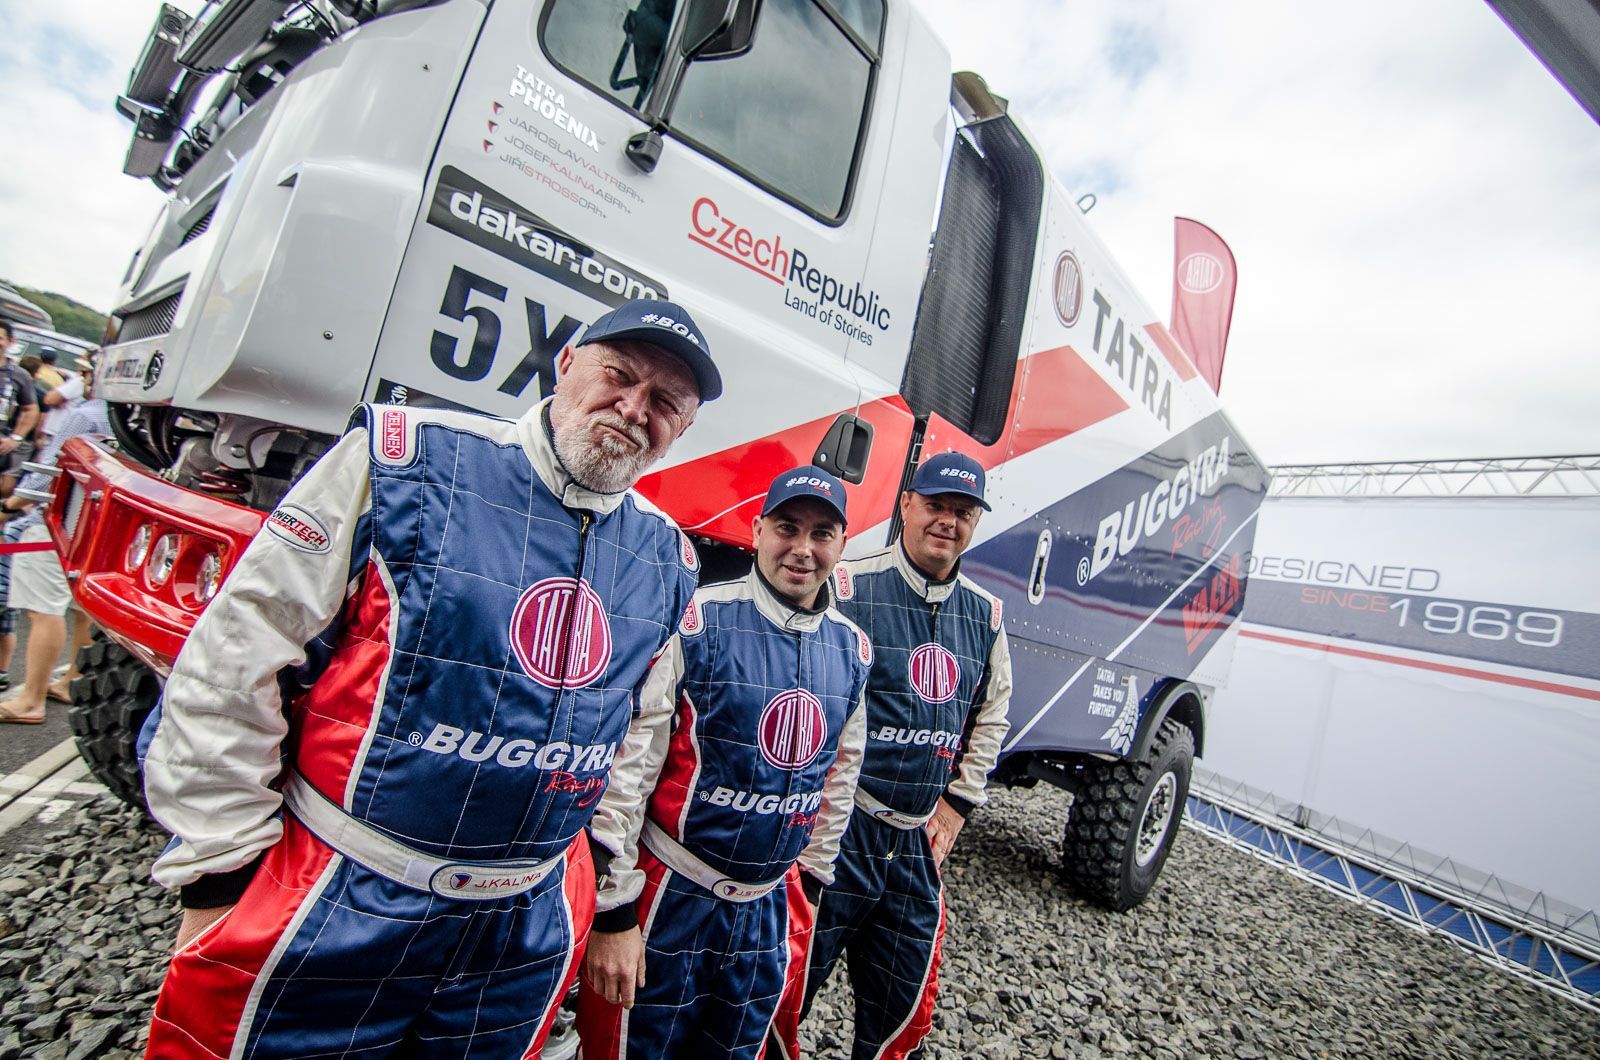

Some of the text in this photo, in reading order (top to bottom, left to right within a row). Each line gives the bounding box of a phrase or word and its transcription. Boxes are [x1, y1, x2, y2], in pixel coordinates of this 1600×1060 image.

[515, 64, 565, 108] TATRA
[509, 78, 600, 152] PHOENIX
[449, 190, 658, 301] dakar.com
[784, 288, 873, 346] Land of Stories
[1092, 288, 1172, 431] TATRA
[531, 589, 594, 677] TATRA
[918, 648, 951, 697] TATRA
[1092, 684, 1126, 703] TAKES YOU
[1096, 667, 1116, 684] TATRA
[771, 697, 815, 762] TATRA
[1087, 700, 1117, 718] FURTHER
[544, 771, 605, 808] Racing
